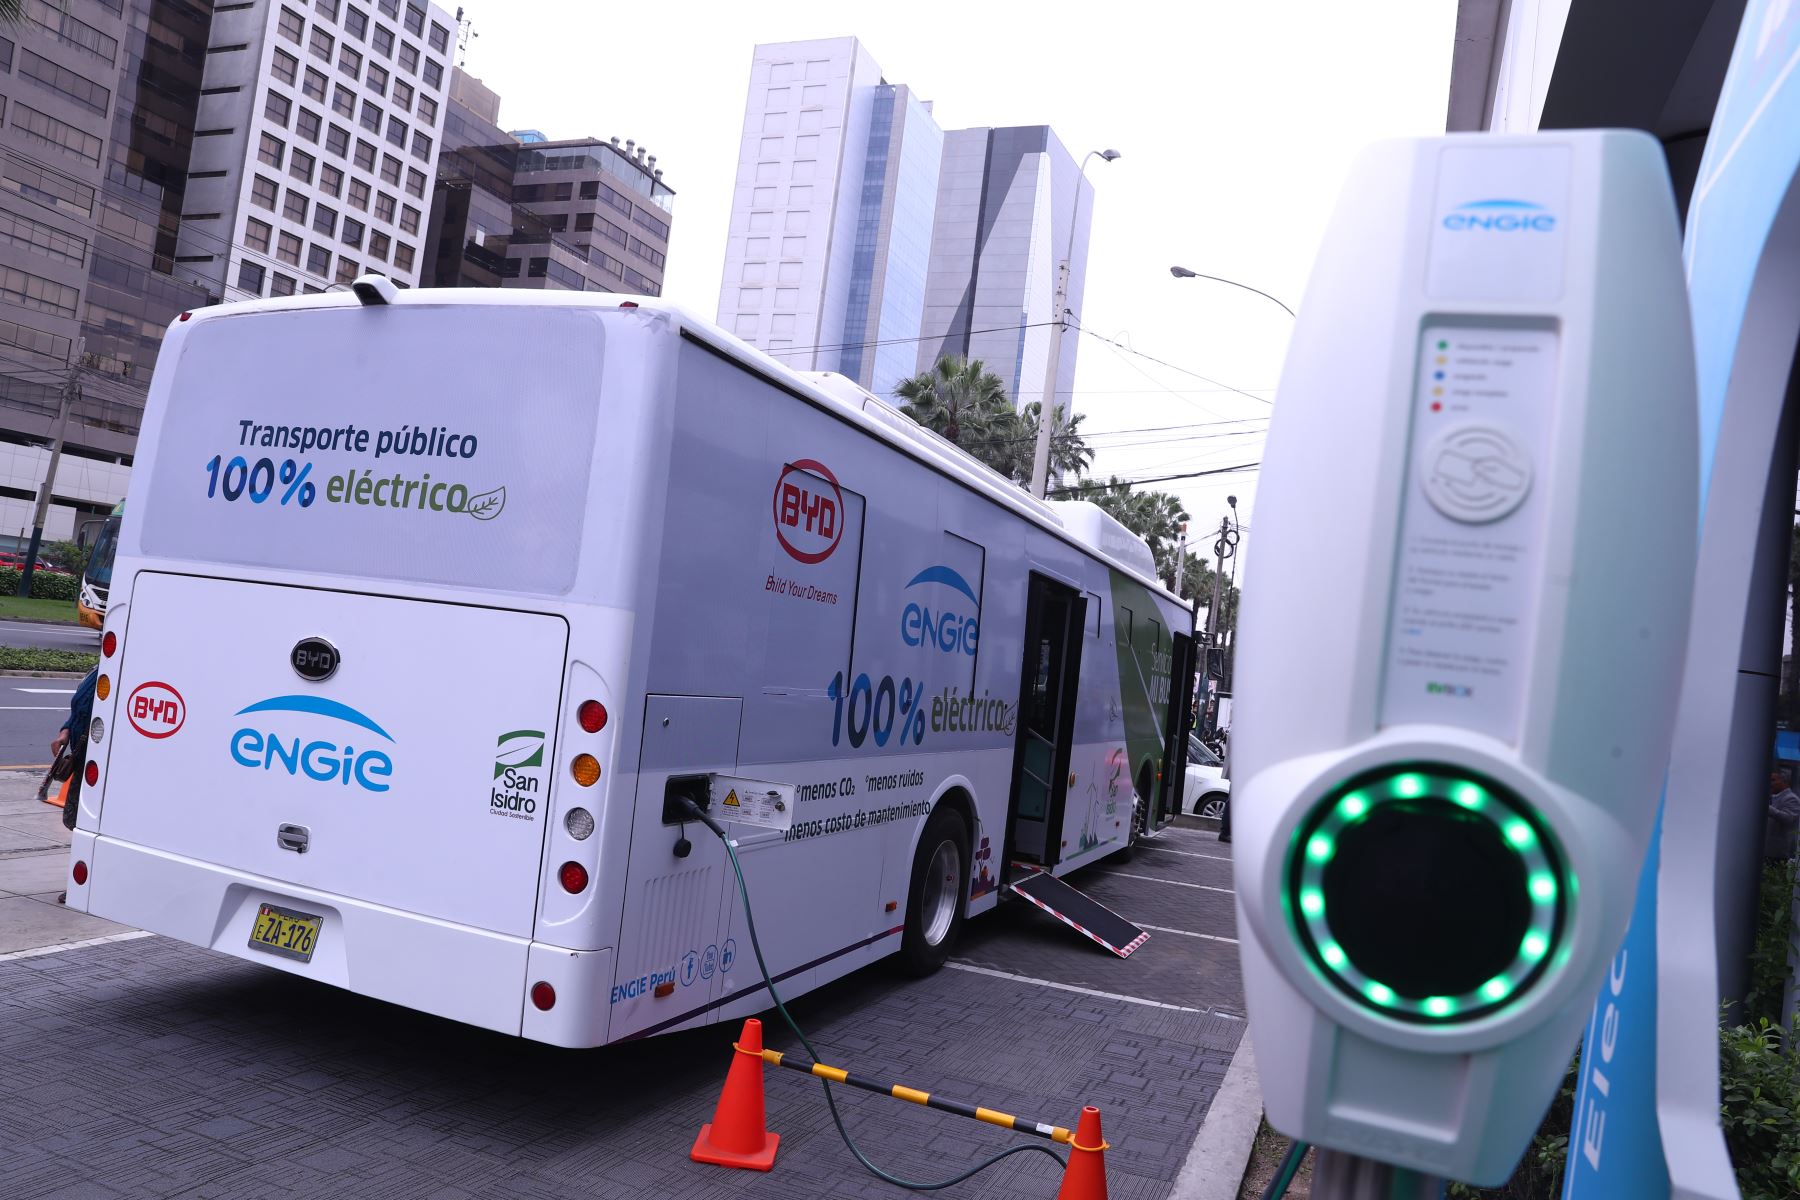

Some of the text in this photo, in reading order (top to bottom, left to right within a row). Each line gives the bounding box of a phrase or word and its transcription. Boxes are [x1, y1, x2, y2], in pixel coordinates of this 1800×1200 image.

[239, 420, 478, 459] Transporte público
[206, 454, 468, 513] 100% eléctrico
[780, 483, 836, 539] BYD
[787, 580, 807, 598] Your
[807, 585, 838, 605] Dreams
[296, 649, 331, 669] BYD
[133, 695, 178, 725] BYD
[828, 671, 1004, 748] 100% eléctrico
[503, 768, 539, 792] San
[898, 769, 924, 788] ruidos
[490, 787, 536, 814] Isidro
[825, 812, 852, 834] costo
[854, 809, 866, 829] de
[867, 800, 931, 826] mantenimiento
[610, 966, 676, 1004] ENGIE Perú
[1584, 905, 1630, 1172] Elec
